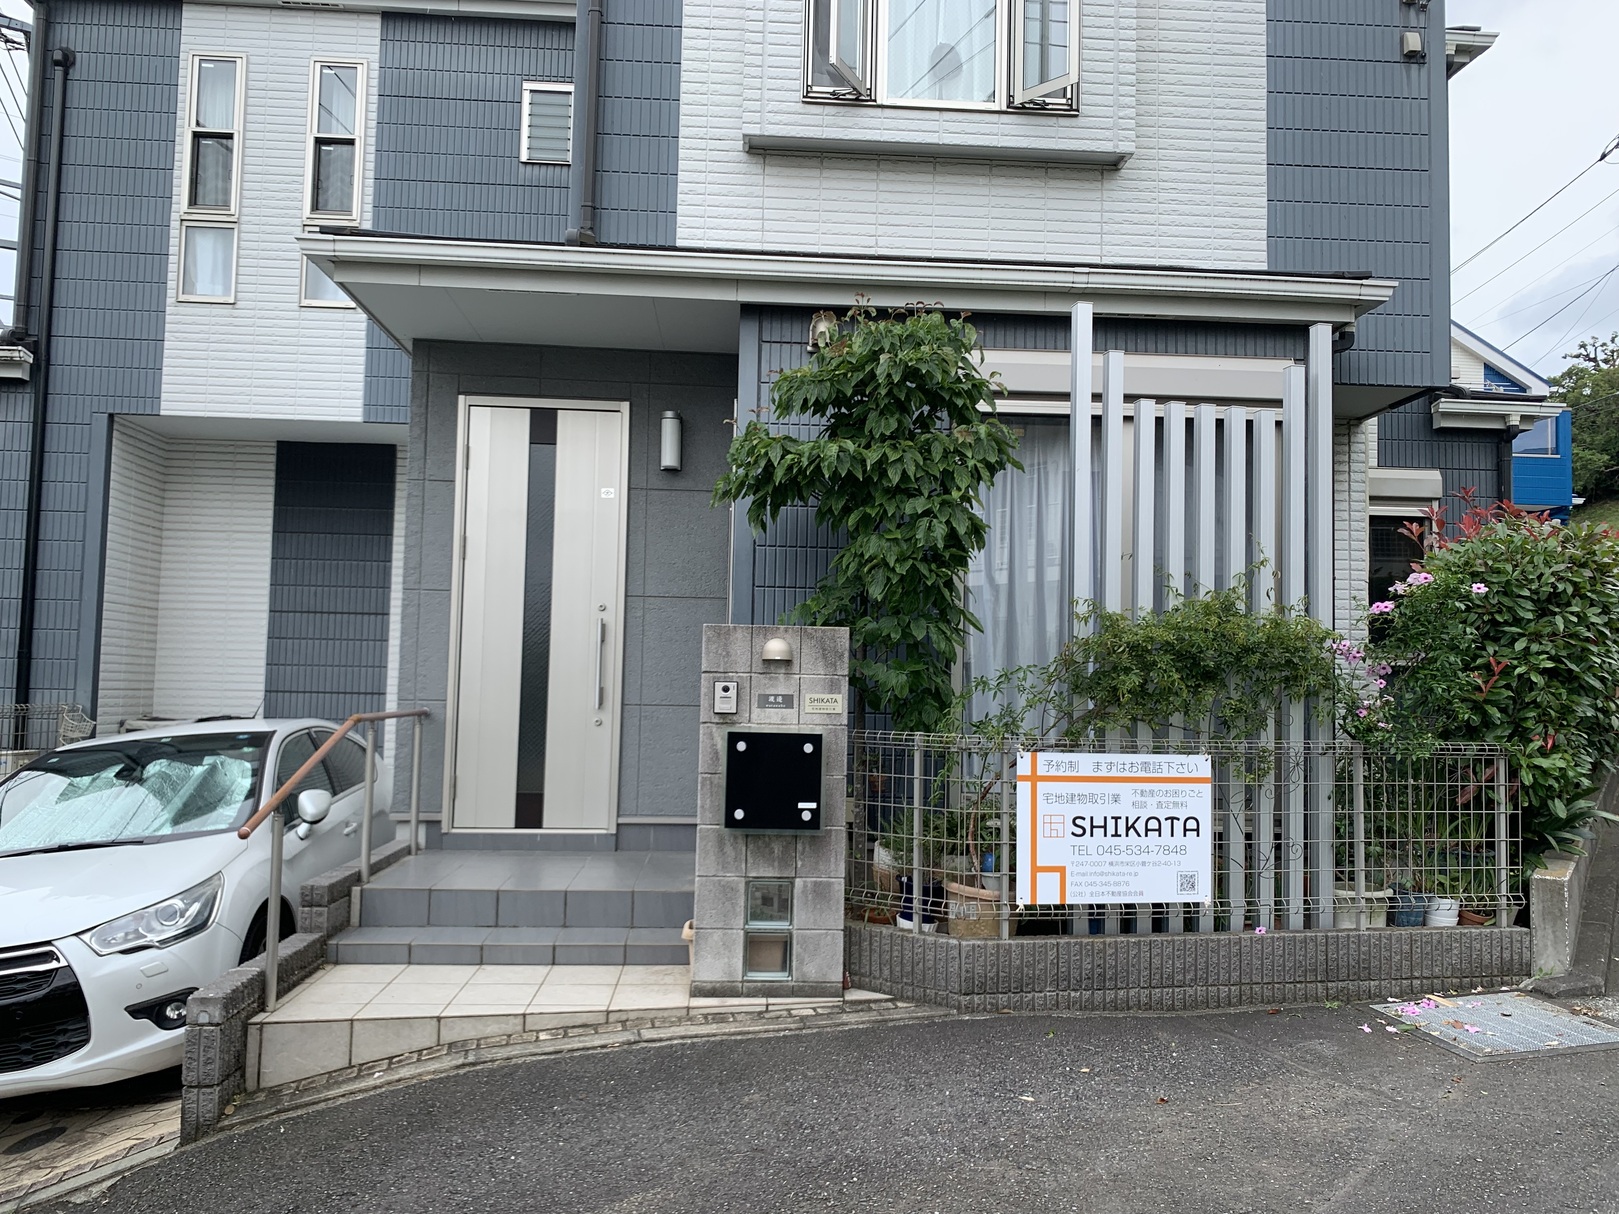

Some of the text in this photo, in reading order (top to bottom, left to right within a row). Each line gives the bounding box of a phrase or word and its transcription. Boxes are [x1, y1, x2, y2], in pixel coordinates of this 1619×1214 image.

[1042, 760, 1199, 774] 予約制 まずはお電話下さい
[1042, 792, 1122, 805] 宅地建物取引業
[1131, 788, 1203, 799] 不動産のお困りごと
[1131, 800, 1188, 810] 相談・査定無料
[1070, 815, 1200, 838] SHIKATA
[1070, 845, 1187, 856] TEL 045-534-7848
[1070, 880, 1083, 888] FAX
